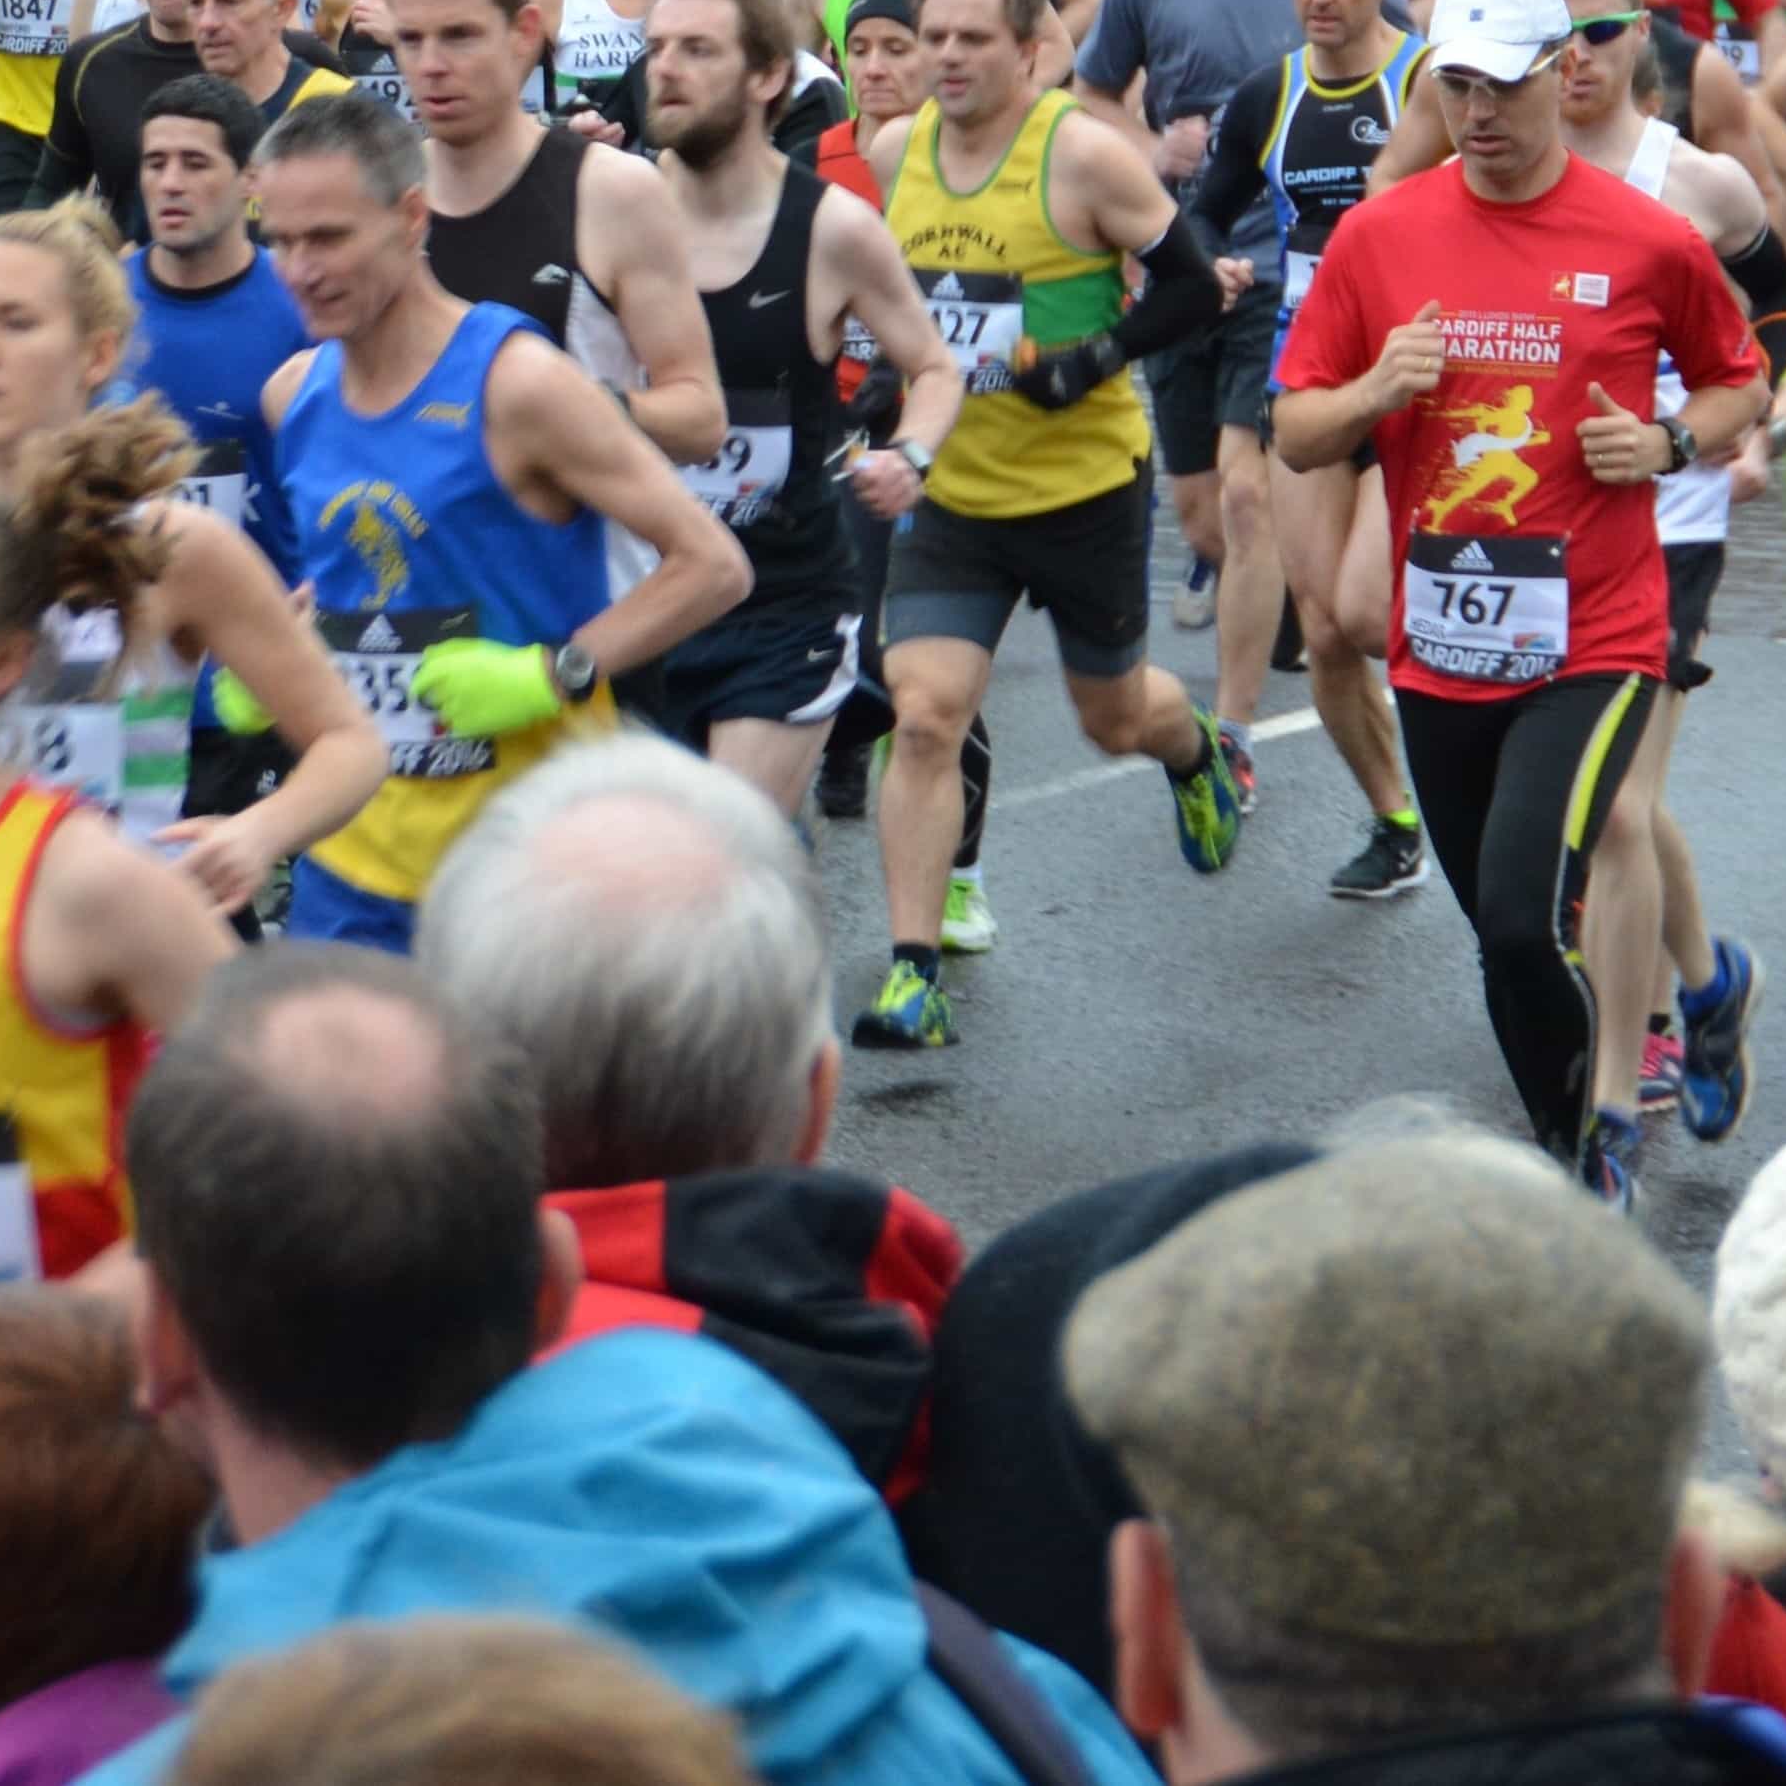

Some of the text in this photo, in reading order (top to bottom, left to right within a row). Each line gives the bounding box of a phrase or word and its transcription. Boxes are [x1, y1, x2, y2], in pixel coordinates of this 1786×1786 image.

[48, 38, 67, 56] 20
[578, 32, 644, 49] SWAN
[1283, 165, 1358, 186] CARDIFF
[902, 225, 1008, 258] CORNWALL
[937, 245, 966, 261] AC
[1513, 322, 1562, 341] HALF
[1431, 578, 1517, 626] 767
[1411, 638, 1557, 680] CARDIFF 2016
